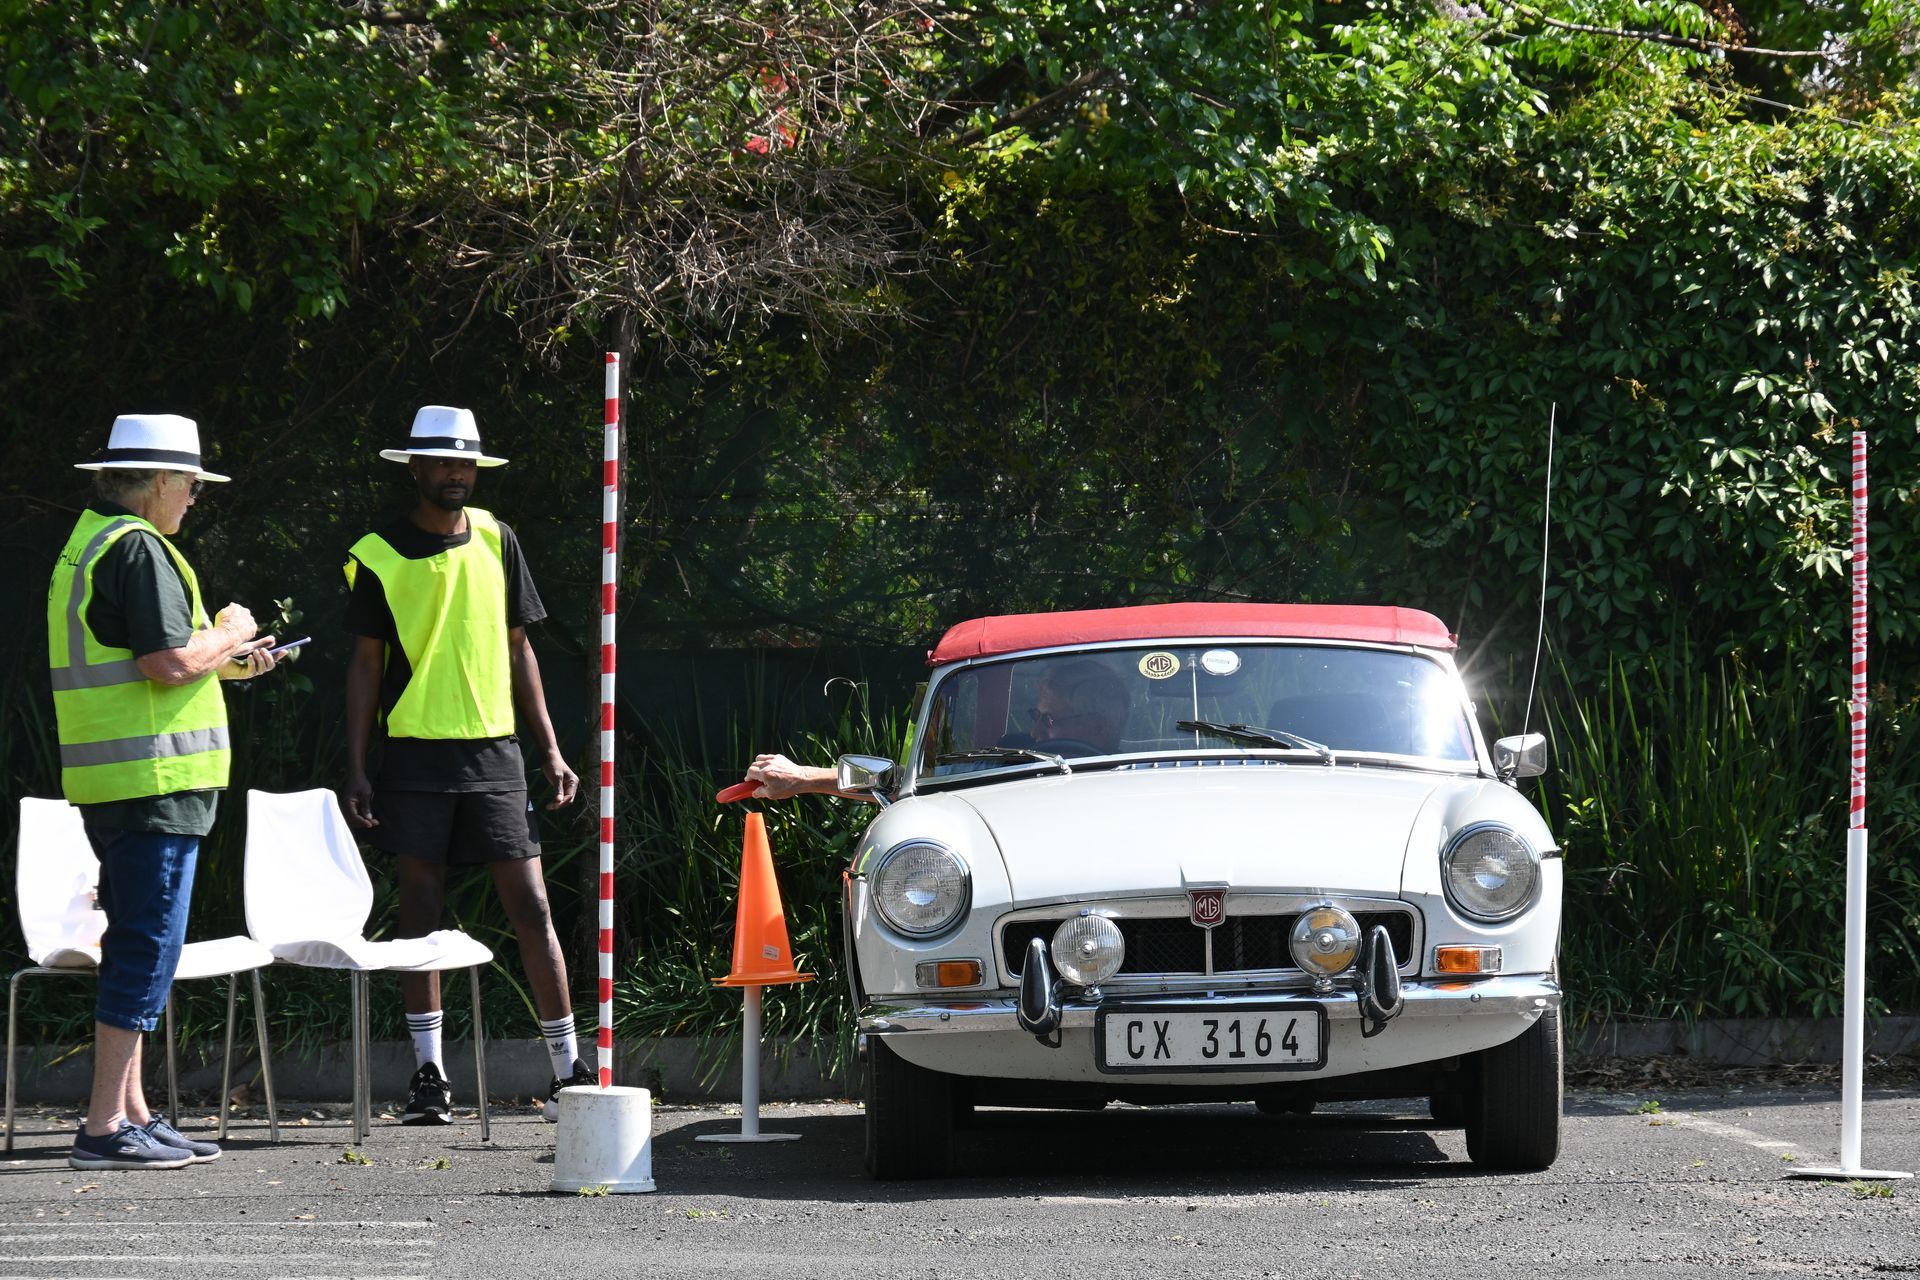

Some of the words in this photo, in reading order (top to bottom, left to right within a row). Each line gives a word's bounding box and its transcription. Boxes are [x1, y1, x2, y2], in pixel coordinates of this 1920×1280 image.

[1149, 657, 1169, 671] MG
[1198, 897, 1217, 917] MG
[1126, 1020, 1171, 1060] CX
[1201, 1018, 1299, 1059] 3164
